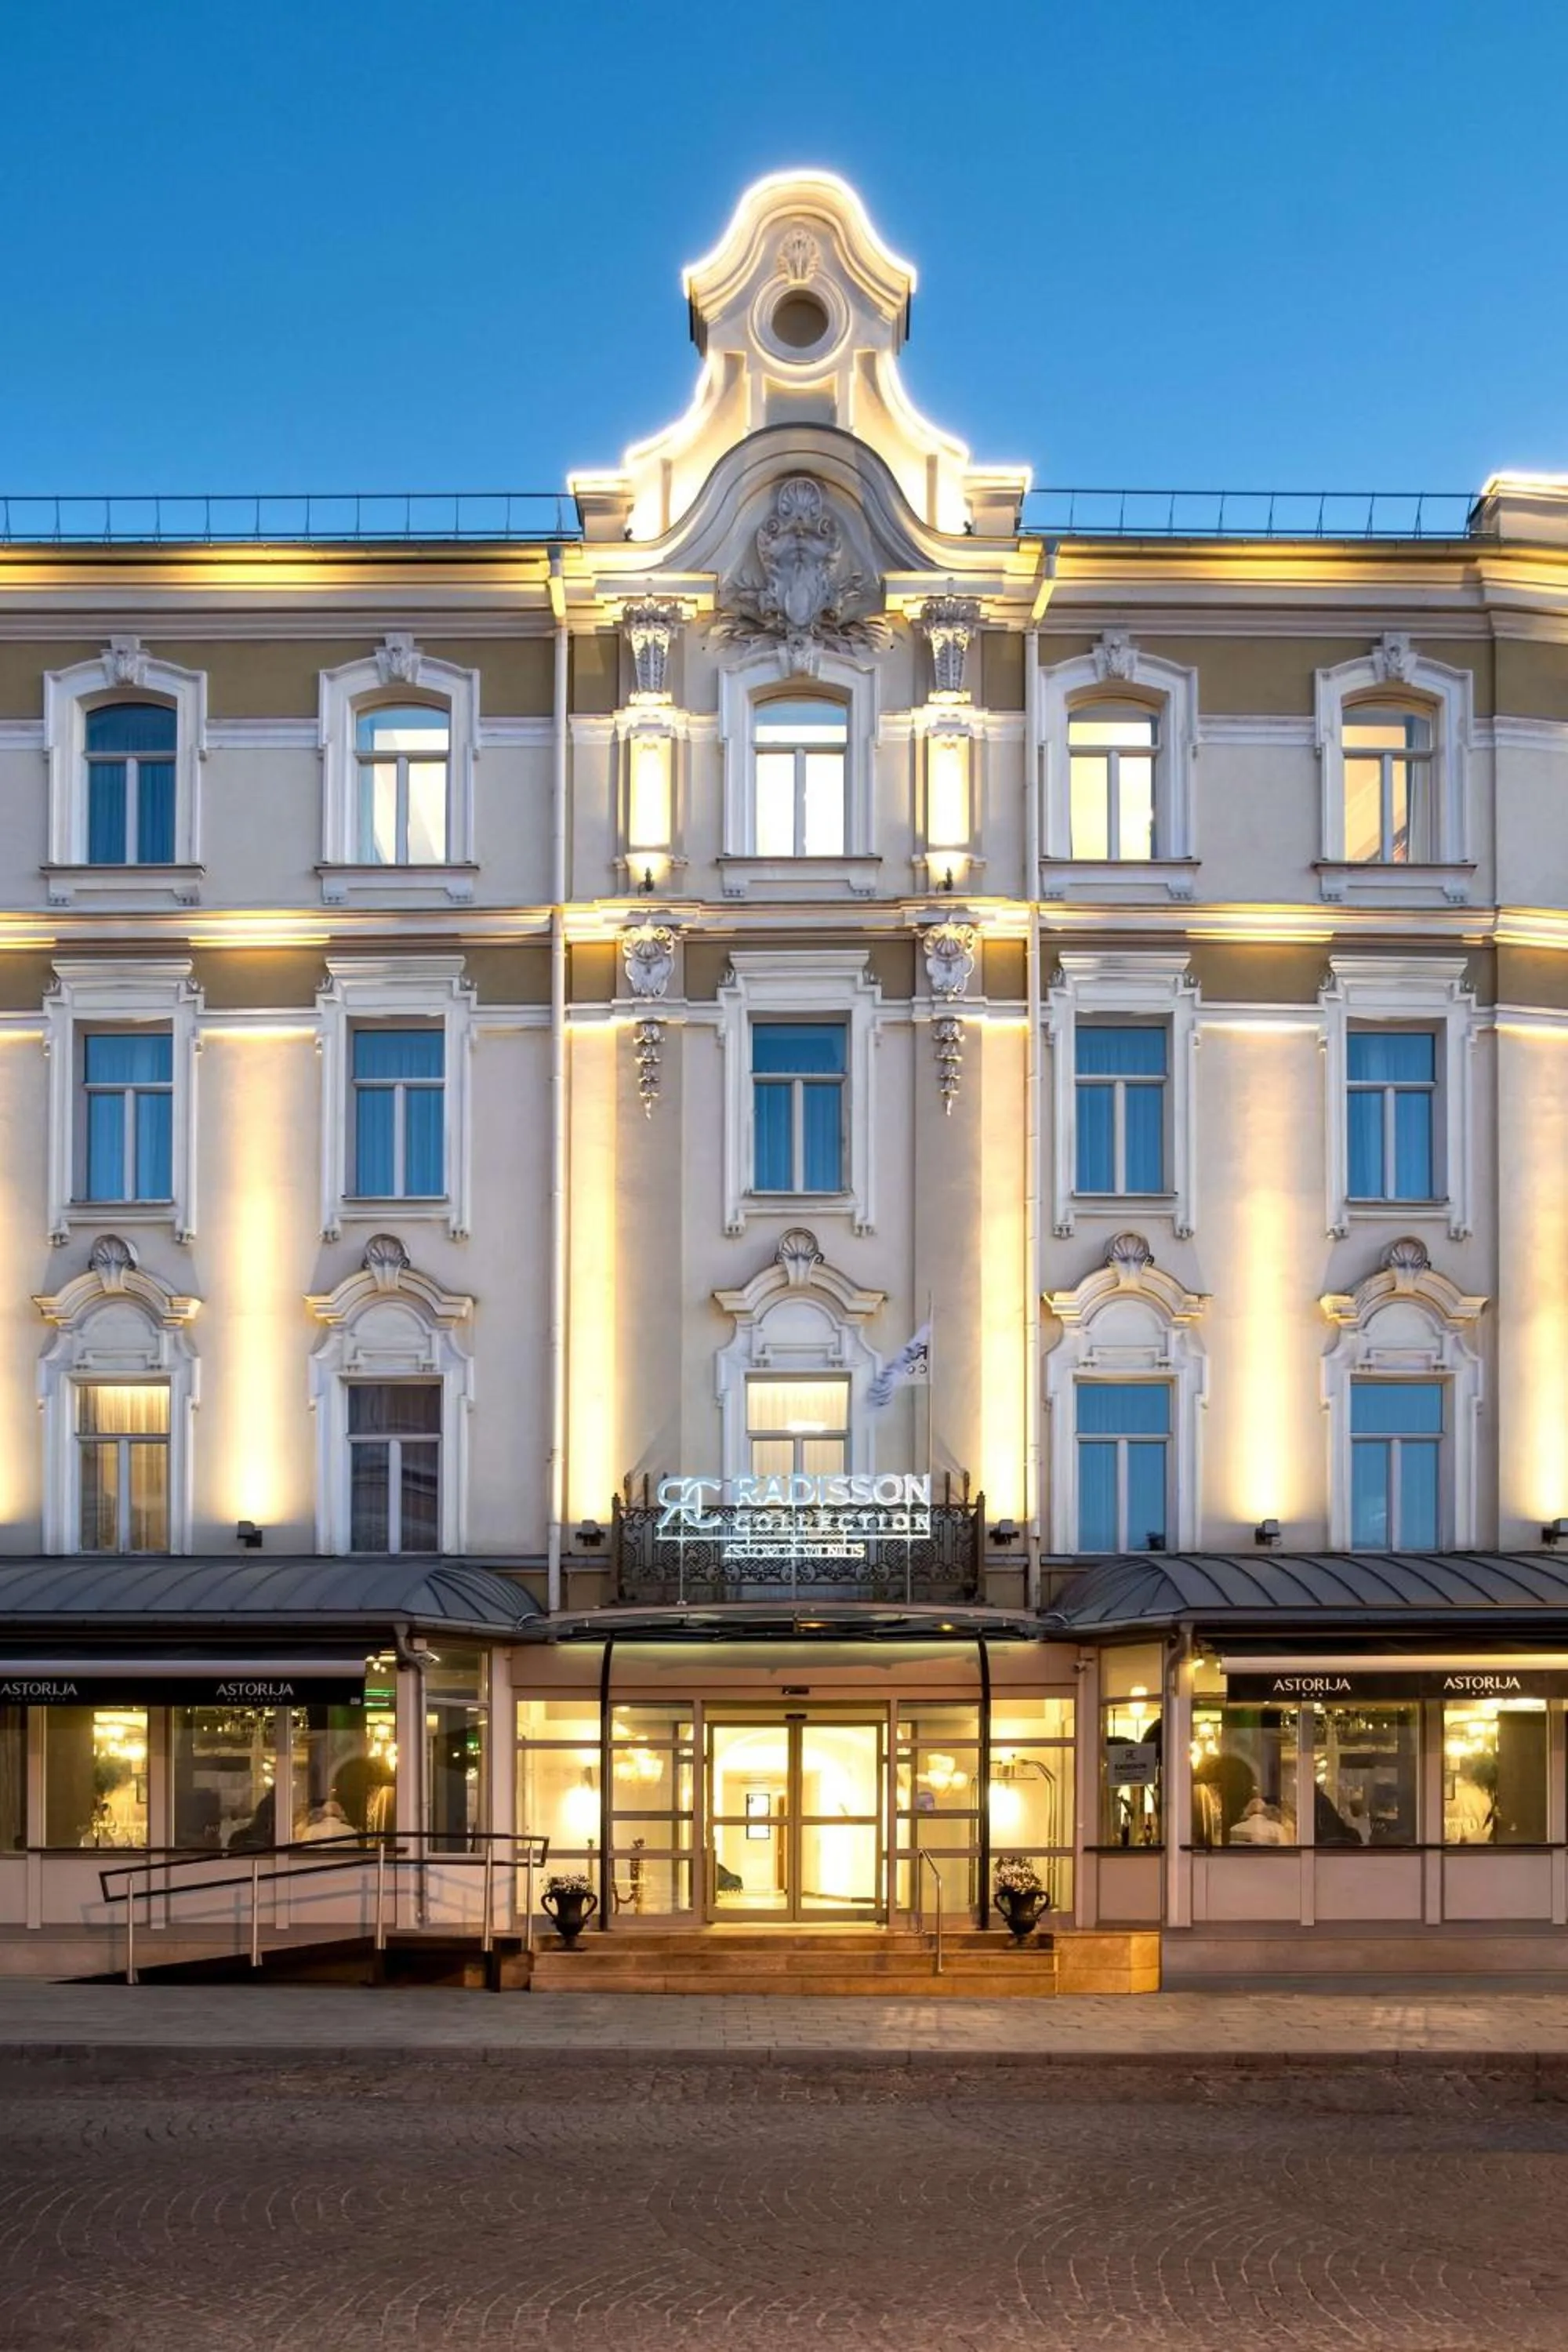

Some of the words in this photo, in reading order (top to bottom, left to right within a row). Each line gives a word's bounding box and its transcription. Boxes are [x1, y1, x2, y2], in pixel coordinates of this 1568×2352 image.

[732, 1474, 931, 1505] RADISSON
[735, 1512, 931, 1532] COLLECTION
[1, 1682, 78, 1695] ASTORIJA
[216, 1682, 294, 1696] ASTORIJA
[1272, 1678, 1351, 1691] ASTORIJA
[1443, 1675, 1521, 1690] ASTORIJA
